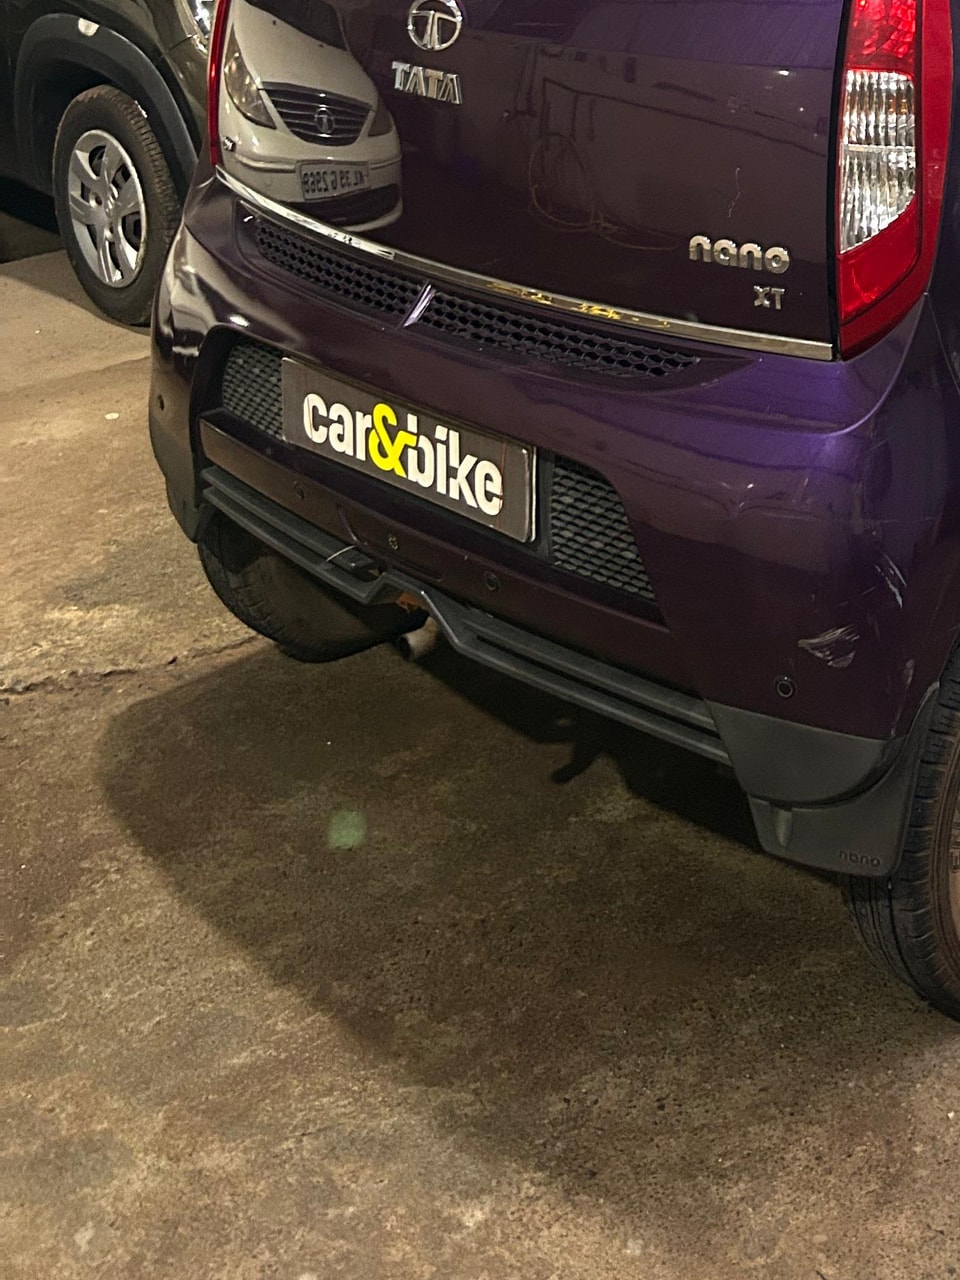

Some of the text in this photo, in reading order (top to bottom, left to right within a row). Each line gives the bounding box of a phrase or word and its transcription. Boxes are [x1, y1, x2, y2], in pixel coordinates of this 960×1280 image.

[392, 61, 462, 104] TATA
[690, 235, 790, 274] nano
[754, 285, 785, 310] XT
[303, 393, 503, 516] car&bike
[839, 850, 881, 868] nano
